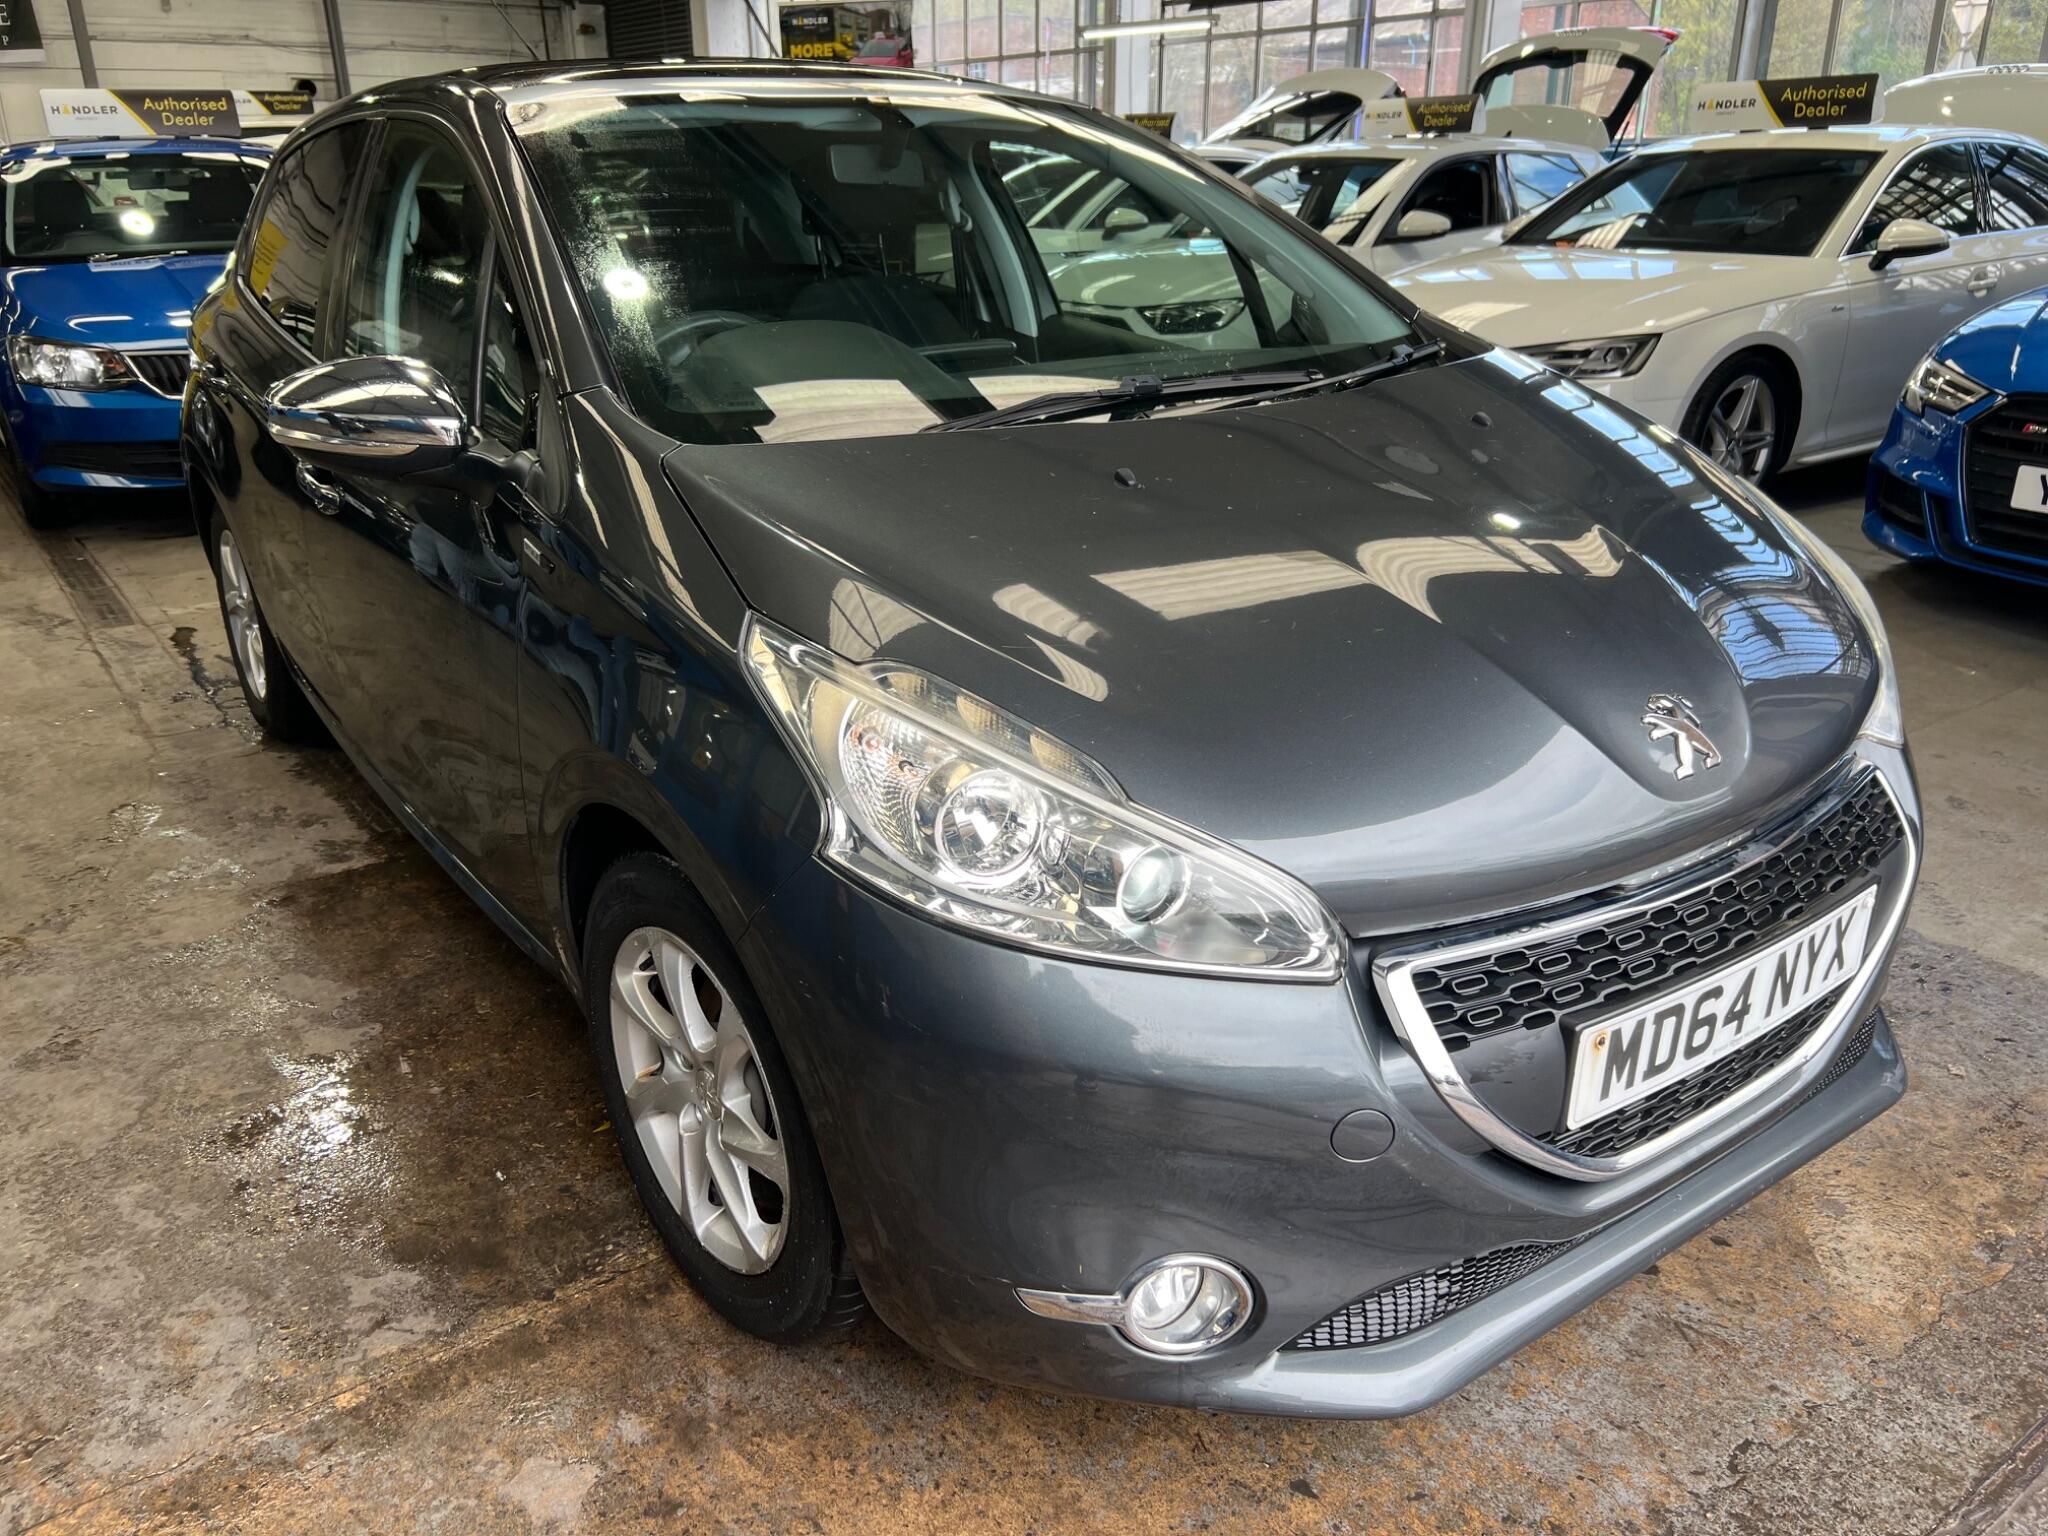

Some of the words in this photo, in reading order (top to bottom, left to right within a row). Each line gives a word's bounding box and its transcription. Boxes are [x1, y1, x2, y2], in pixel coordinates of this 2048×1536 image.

[790, 42, 834, 58] MORE
[264, 94, 309, 103] Authorised
[1780, 82, 1868, 102] Authorised
[51, 104, 118, 115] HANDLER
[143, 97, 228, 112] Authorised
[273, 102, 302, 111] Dealer
[1417, 101, 1473, 114] Authorised
[1697, 97, 1757, 112] HANDLER
[1793, 103, 1847, 118] Dealer
[162, 112, 215, 126] Dealer
[1423, 114, 1458, 127] Dealer
[1599, 966, 1758, 1103] MD64
[1763, 904, 1858, 1021] NYX
